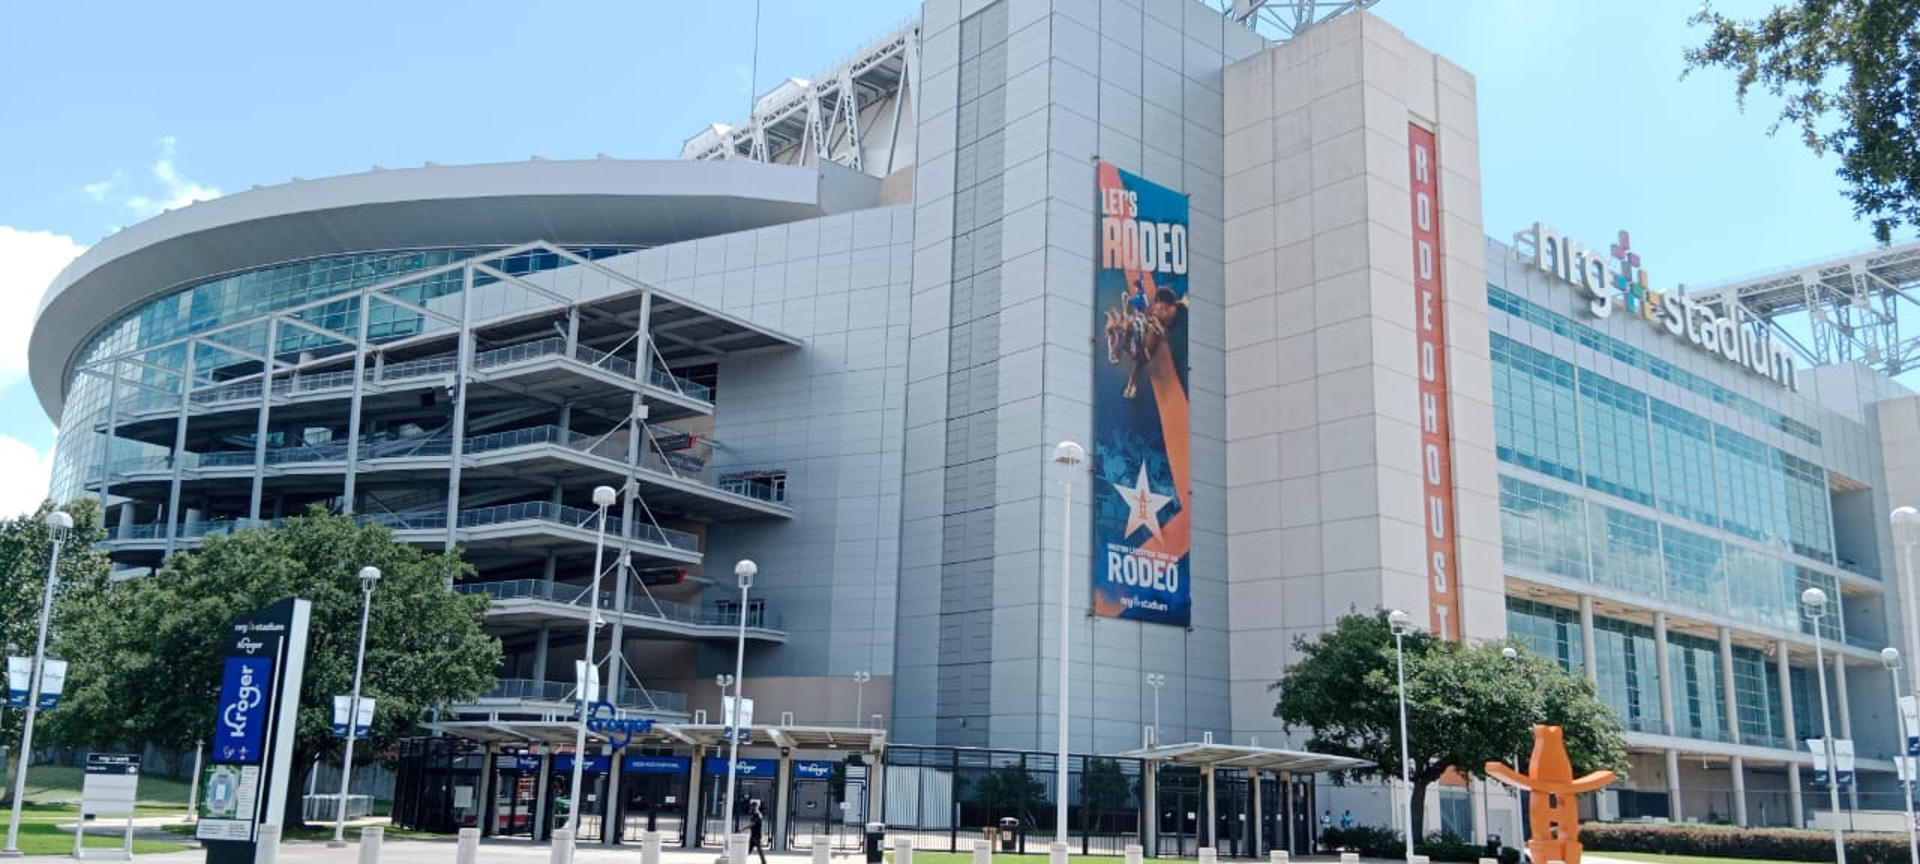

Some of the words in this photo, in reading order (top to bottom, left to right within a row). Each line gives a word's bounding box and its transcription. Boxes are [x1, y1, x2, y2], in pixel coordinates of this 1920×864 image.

[1102, 188, 1138, 218] LET'S
[1102, 217, 1187, 275] RODEO
[1533, 221, 1612, 319] nrg
[1661, 284, 1799, 392] stadium
[1108, 550, 1179, 594] RODEO
[223, 664, 262, 738] Kroger
